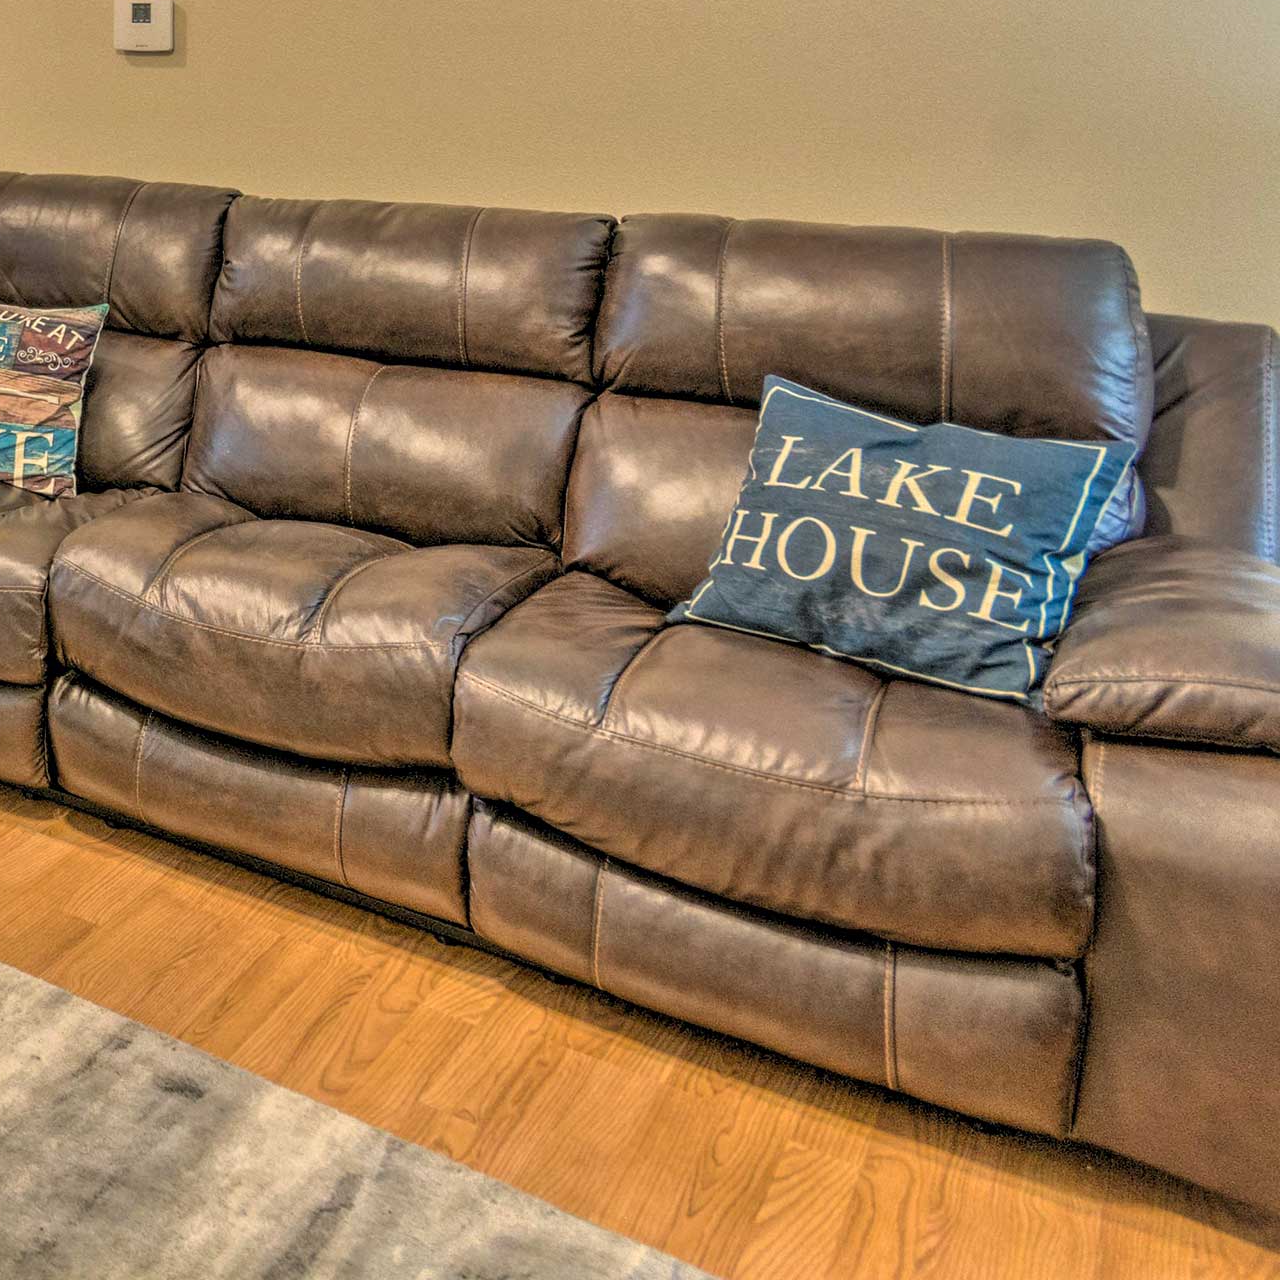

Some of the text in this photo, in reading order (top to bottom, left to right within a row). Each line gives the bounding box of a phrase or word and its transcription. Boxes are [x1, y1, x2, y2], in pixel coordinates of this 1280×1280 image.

[47, 324, 85, 351] AT
[763, 435, 1023, 538] LAKE
[720, 509, 1036, 632] HOUSE
